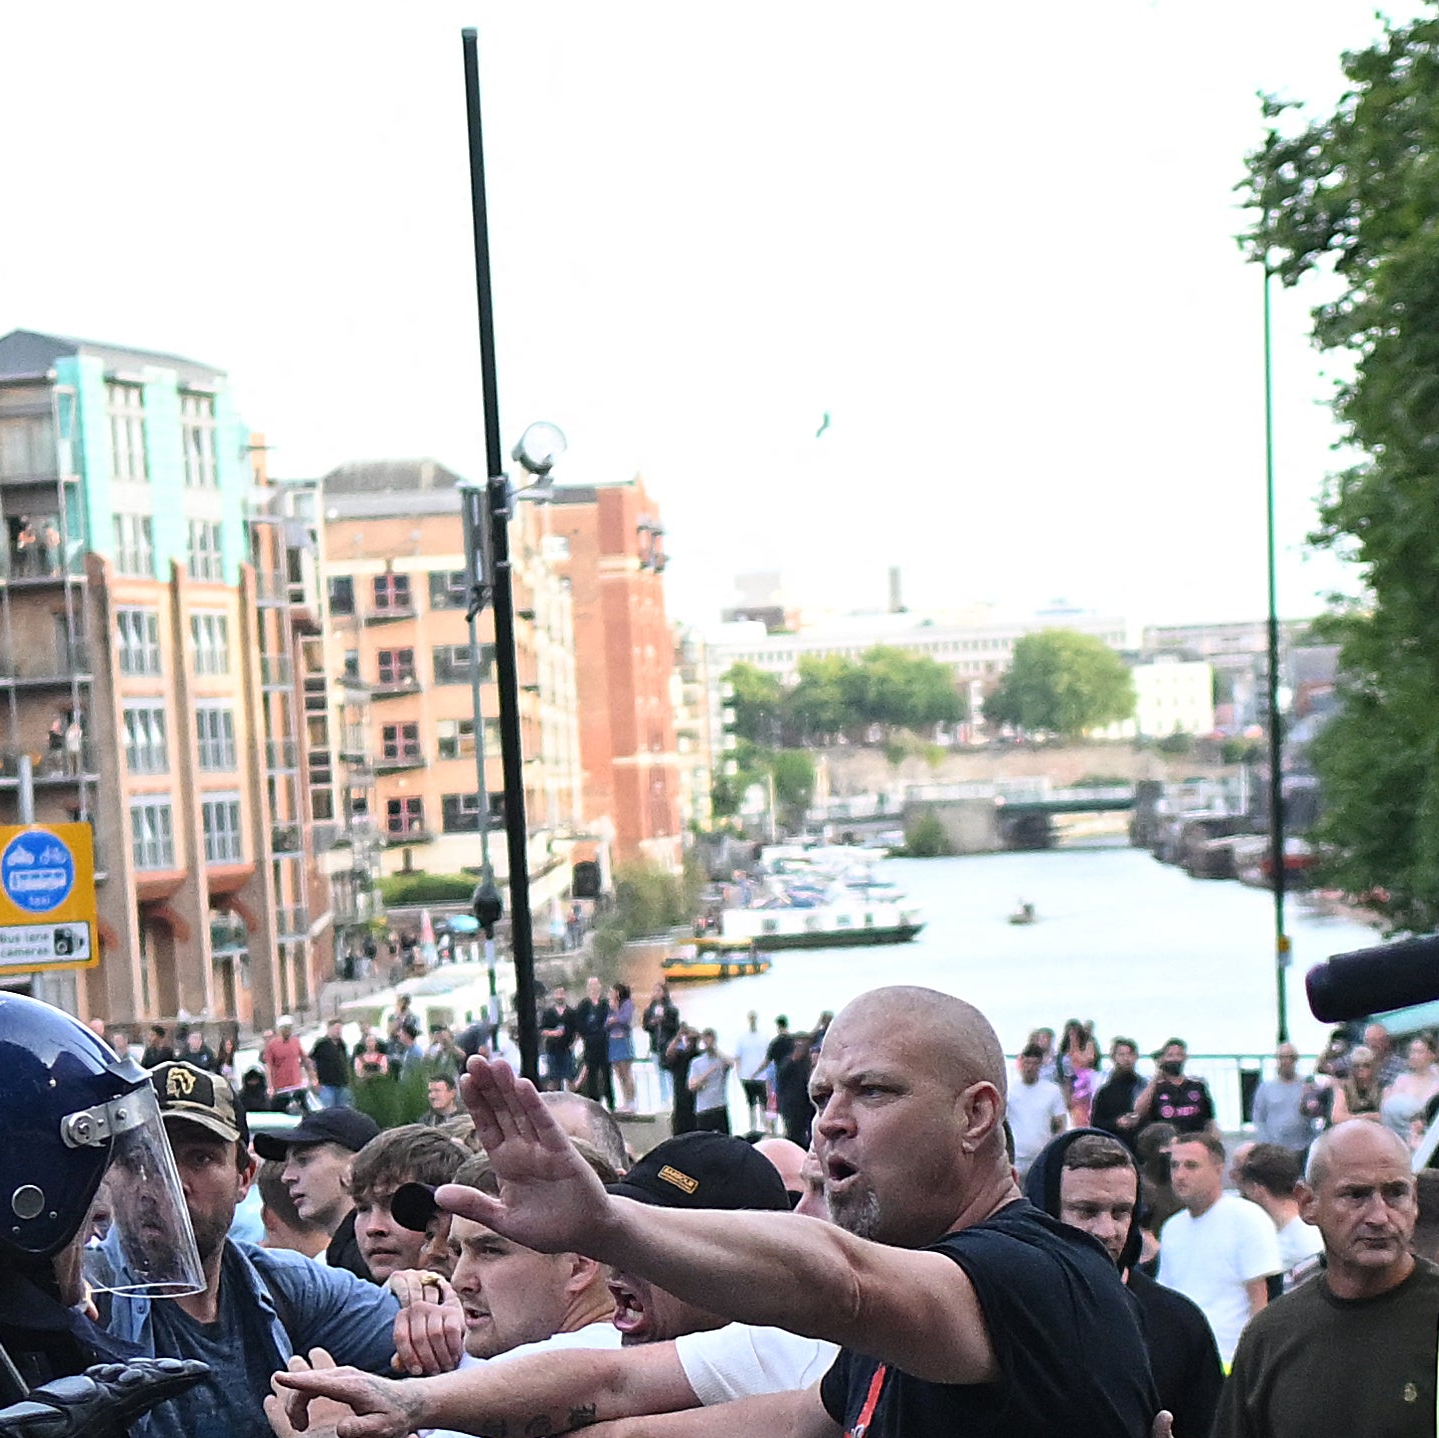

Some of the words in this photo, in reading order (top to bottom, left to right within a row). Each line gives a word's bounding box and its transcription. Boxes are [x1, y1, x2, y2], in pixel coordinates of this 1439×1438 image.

[0, 933, 21, 944] Bus
[25, 931, 50, 942] lane
[0, 946, 50, 958] cameras
